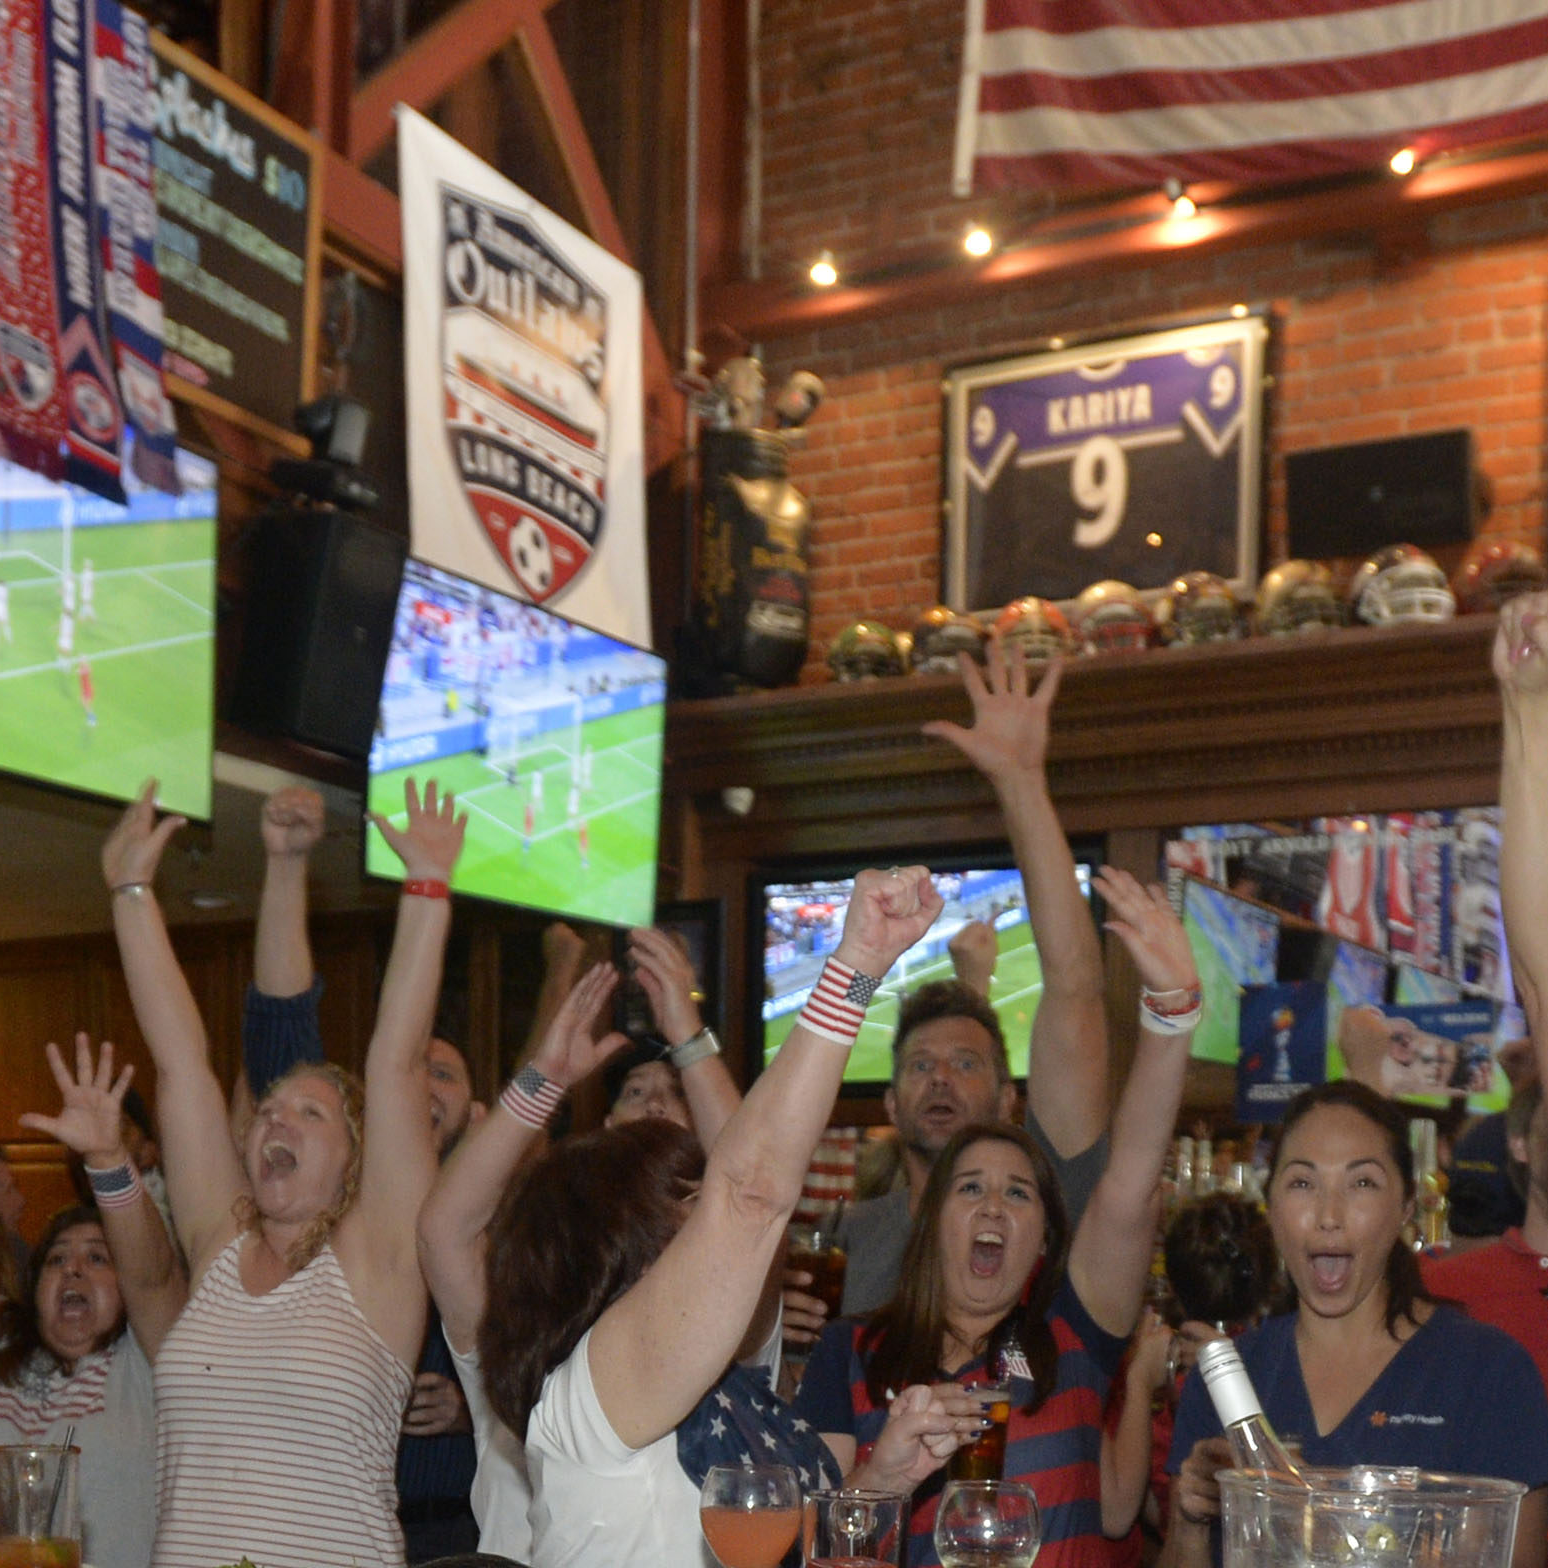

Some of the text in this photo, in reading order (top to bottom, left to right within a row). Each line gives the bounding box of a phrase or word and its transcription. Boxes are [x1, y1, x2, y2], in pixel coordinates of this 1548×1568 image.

[1047, 383, 1152, 436] KARIYA
[1209, 365, 1237, 410] 9
[1070, 436, 1129, 549] 9
